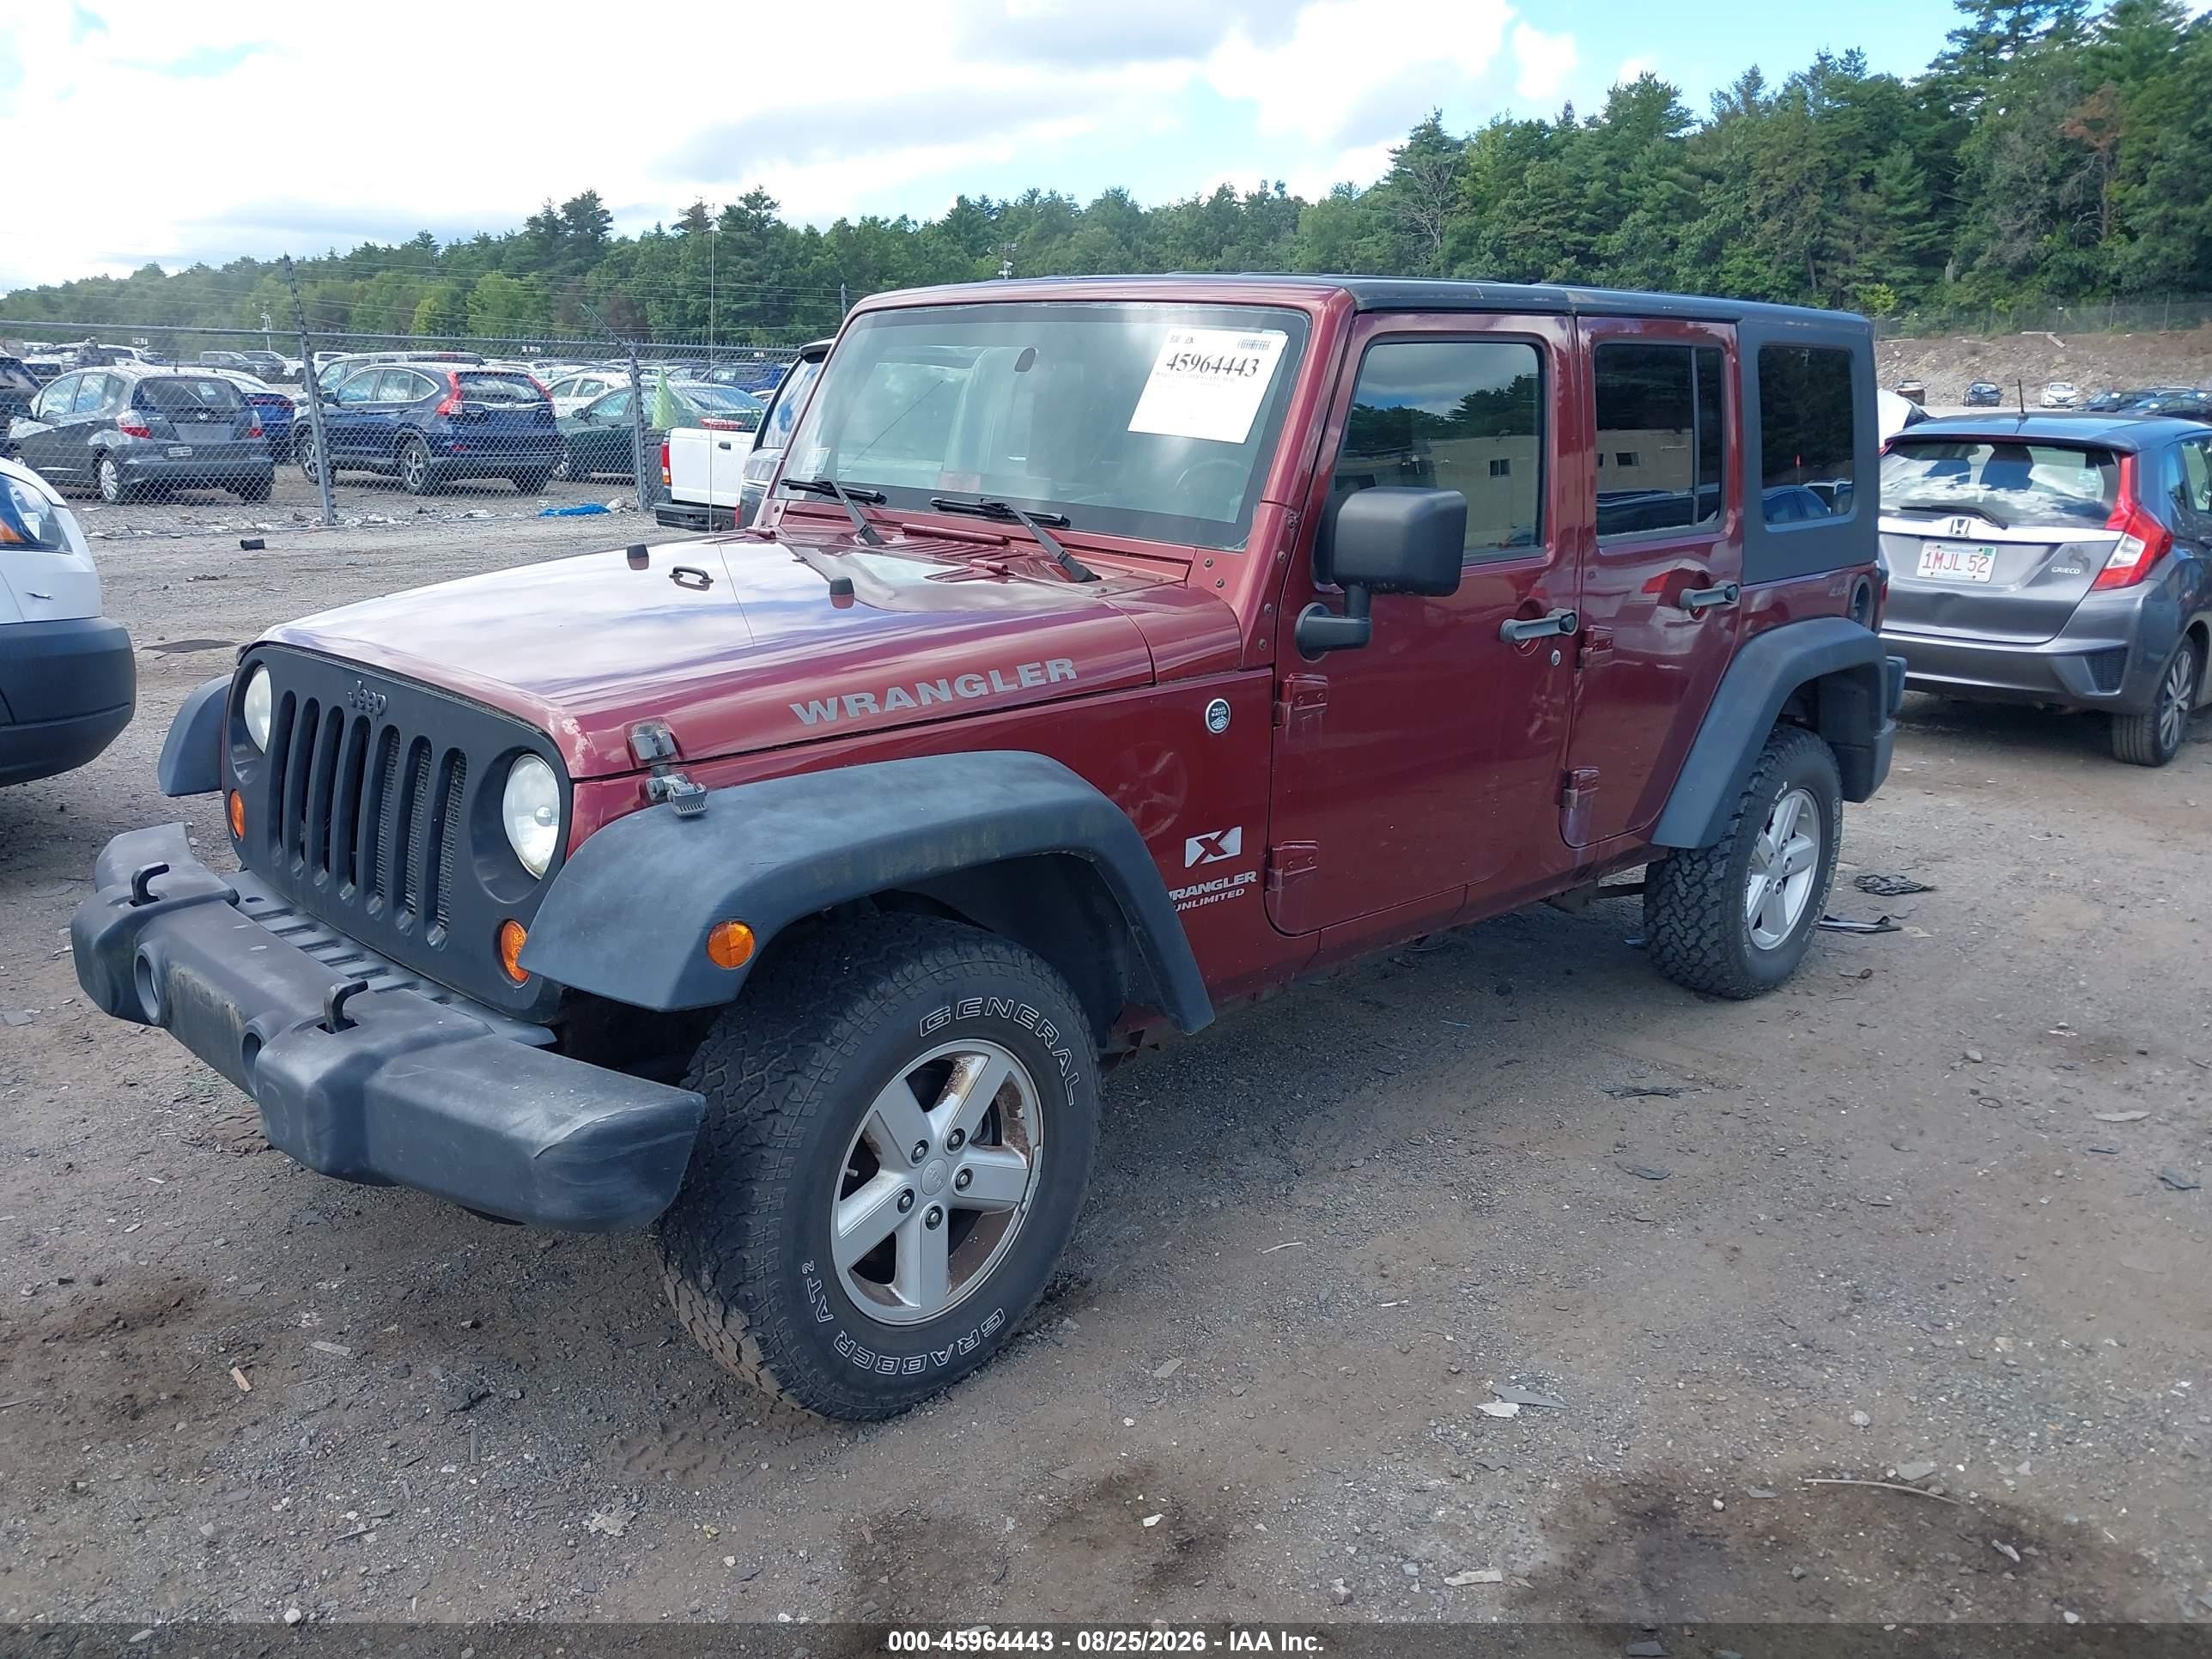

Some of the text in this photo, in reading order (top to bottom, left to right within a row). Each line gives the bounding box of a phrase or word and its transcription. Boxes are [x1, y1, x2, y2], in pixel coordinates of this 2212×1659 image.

[1165, 352, 1261, 378] 45964443
[1922, 550, 1962, 571] 1MJL
[1967, 554, 1990, 574] 52
[346, 679, 387, 721] Jeep
[788, 657, 1079, 726] WRANGLER
[919, 996, 1080, 1107] GENERAL
[833, 1307, 1006, 1376] GRABBER
